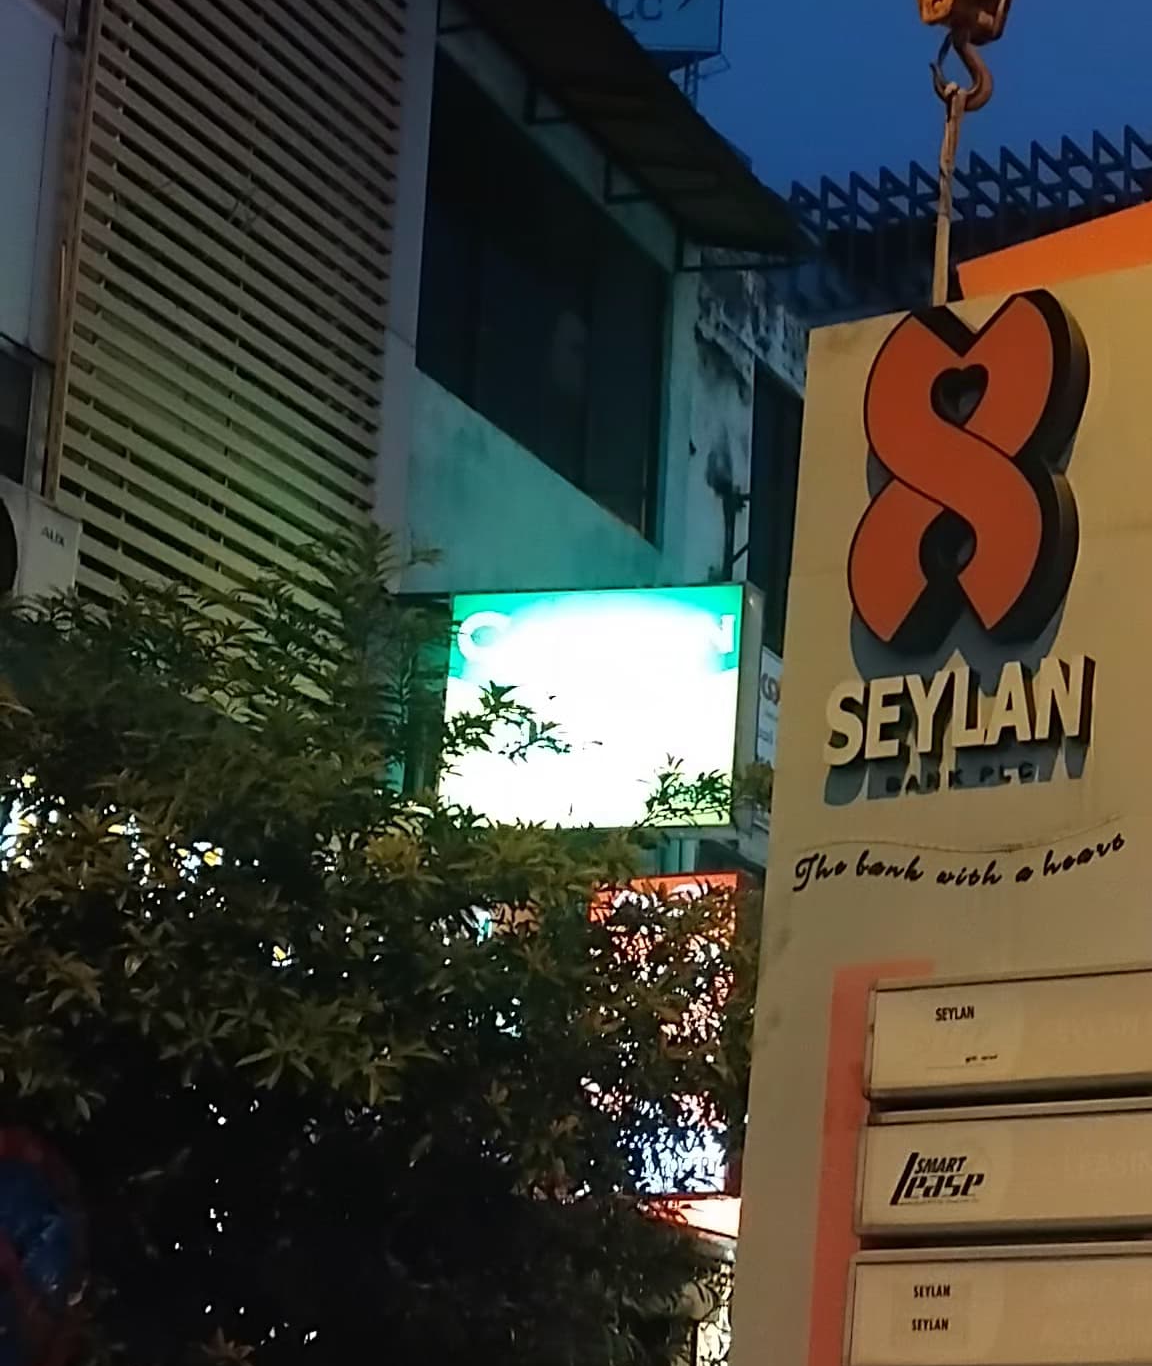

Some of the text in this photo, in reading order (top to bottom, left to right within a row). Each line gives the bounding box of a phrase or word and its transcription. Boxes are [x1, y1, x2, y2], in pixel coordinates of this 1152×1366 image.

[822, 655, 1096, 768] SEYLAN
[979, 762, 1034, 785] PLC
[792, 832, 1126, 892] The bank with a heart
[935, 1005, 975, 1023] SEYLAN
[913, 1155, 968, 1174] SMART
[913, 1284, 951, 1299] SEYLAN
[910, 1318, 949, 1332] SEYLAN
